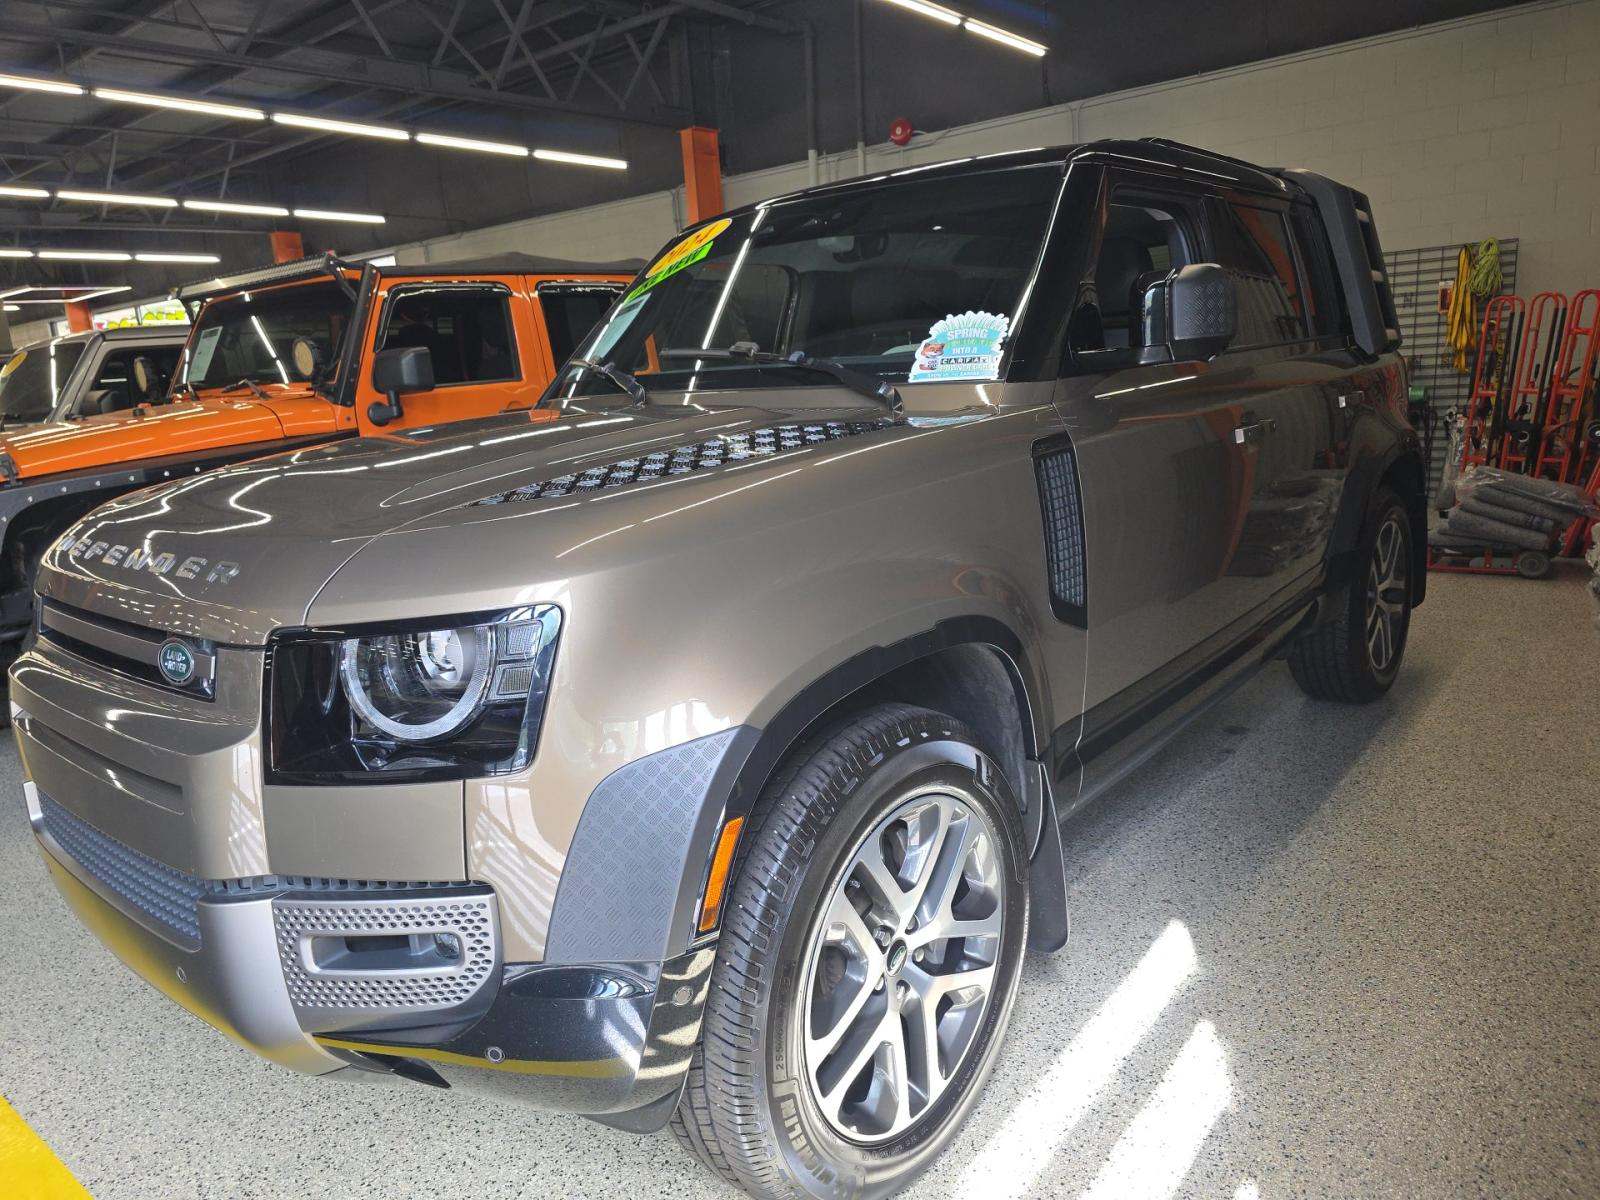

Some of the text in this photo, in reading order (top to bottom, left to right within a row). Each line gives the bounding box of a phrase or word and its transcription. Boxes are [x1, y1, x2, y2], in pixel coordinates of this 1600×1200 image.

[948, 327, 989, 340] SPRING
[940, 356, 989, 365] CARFAX
[61, 535, 240, 584] DEFENDER
